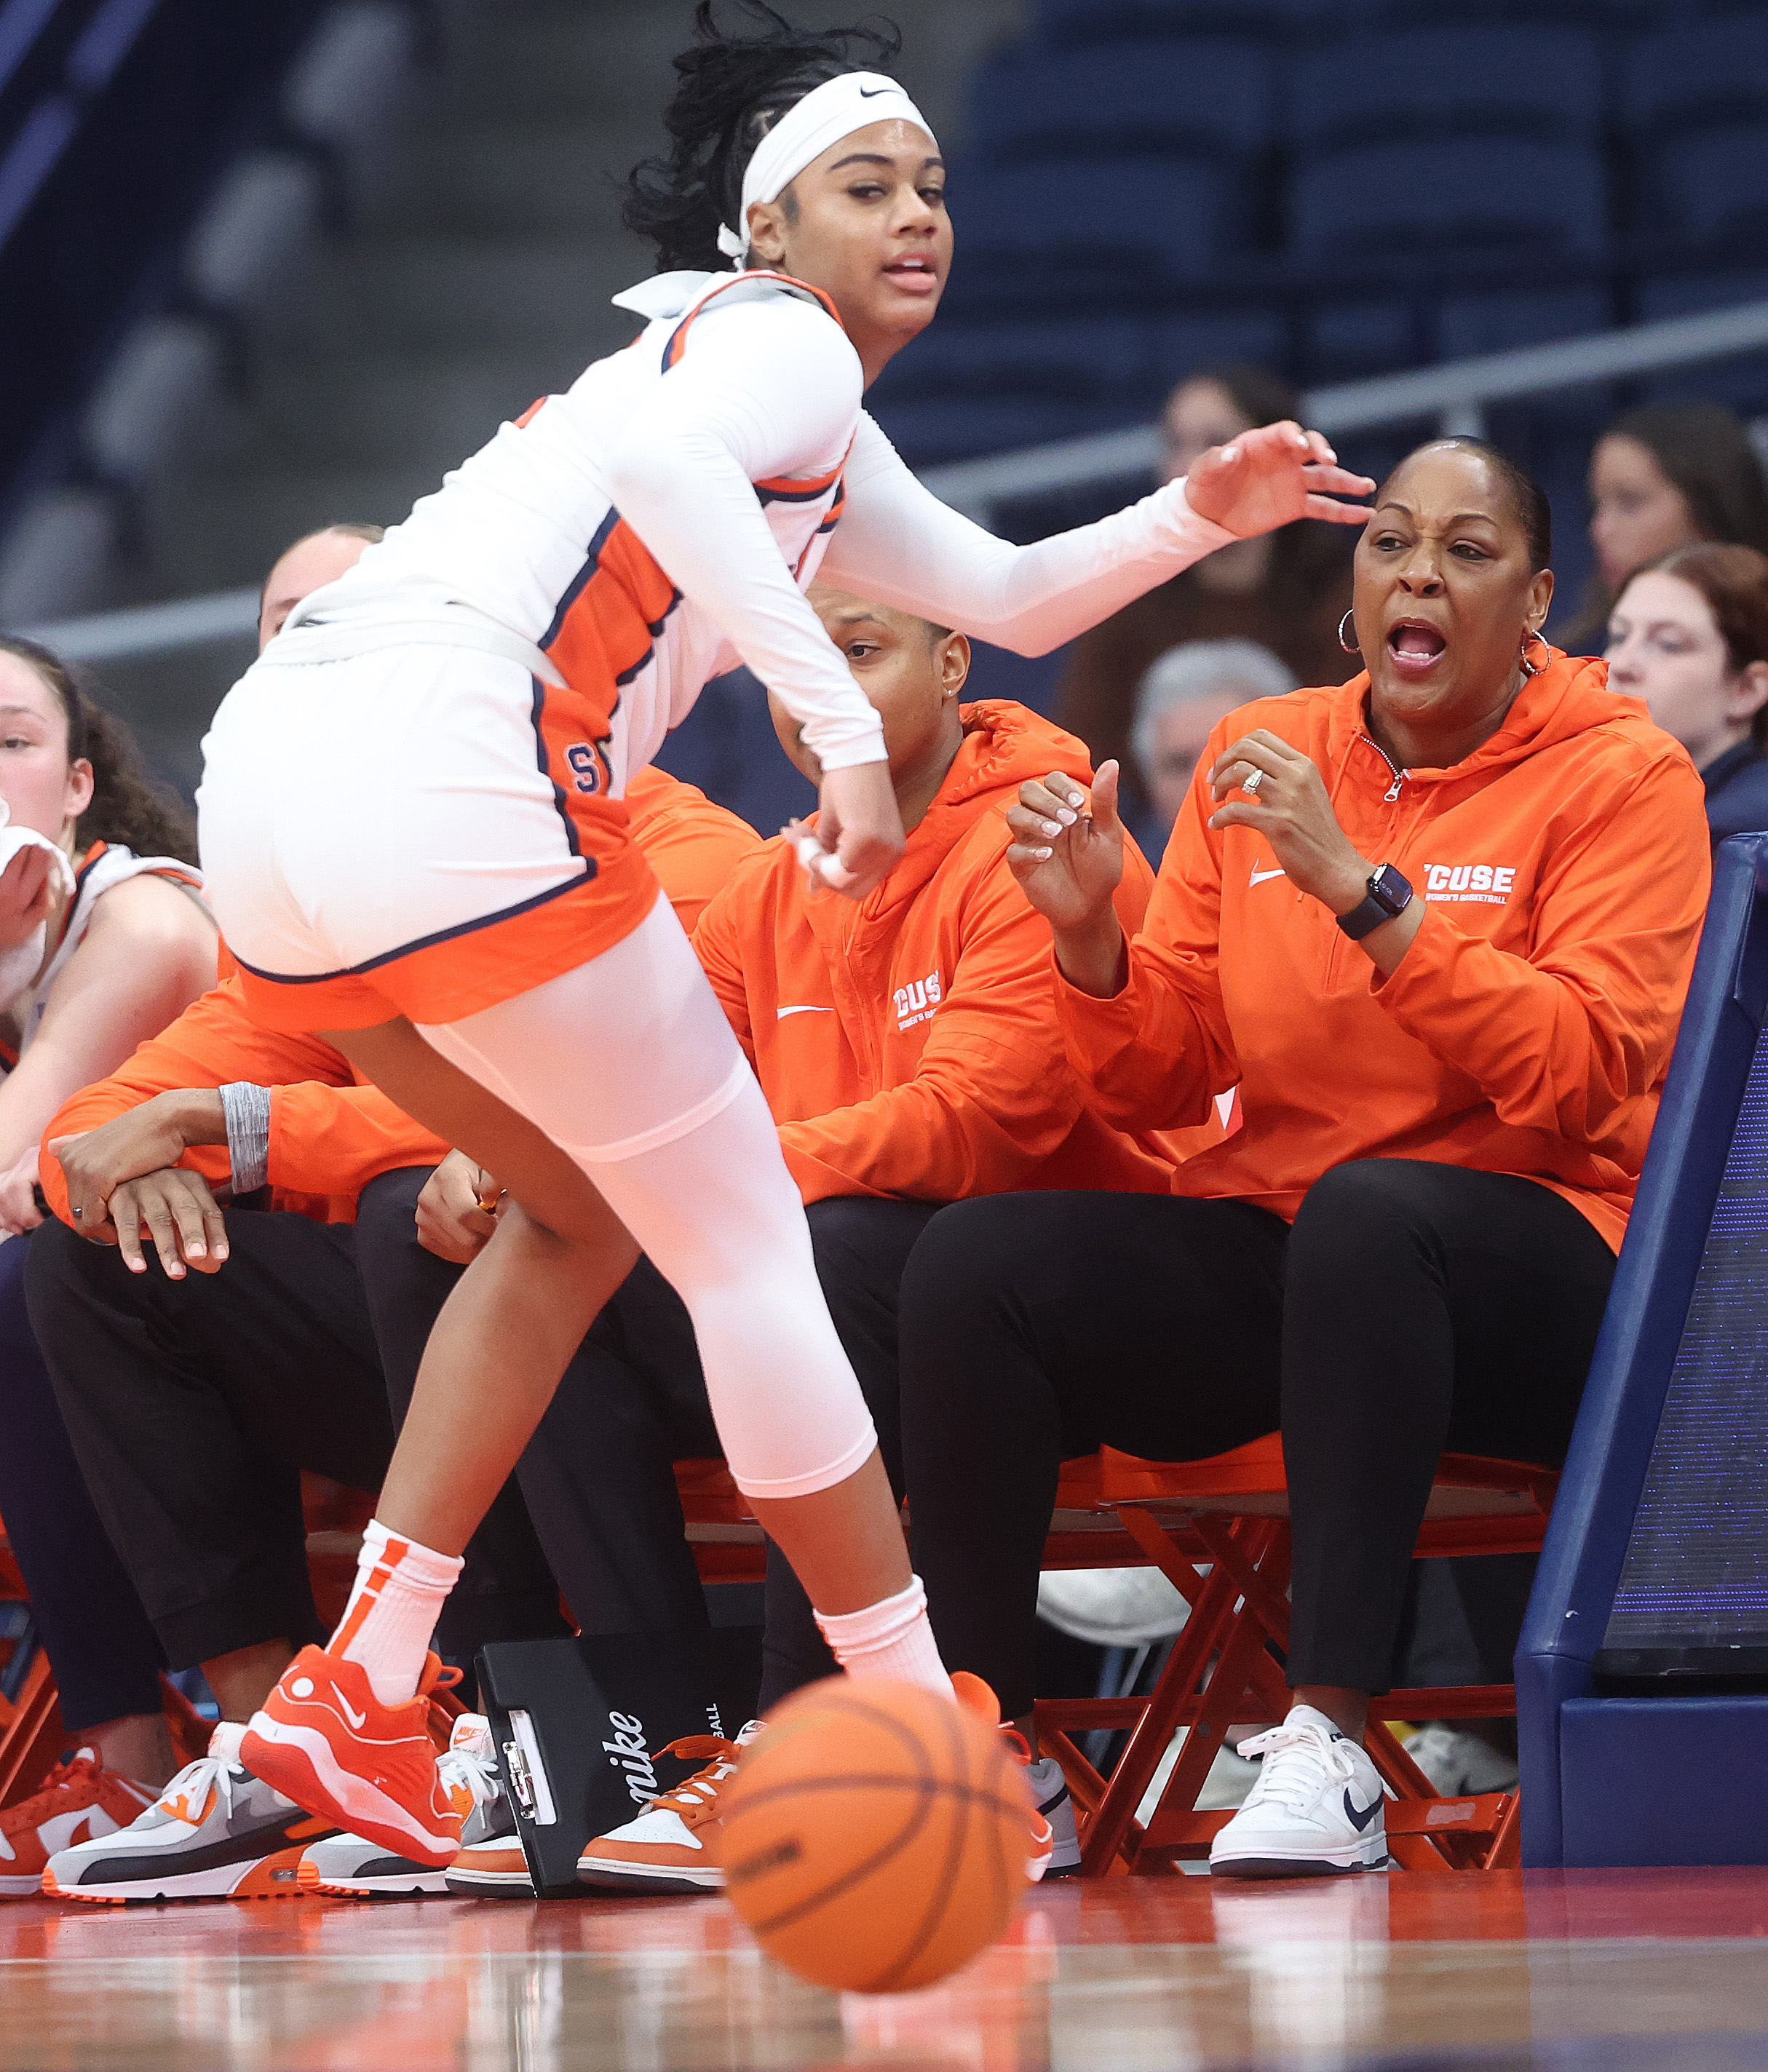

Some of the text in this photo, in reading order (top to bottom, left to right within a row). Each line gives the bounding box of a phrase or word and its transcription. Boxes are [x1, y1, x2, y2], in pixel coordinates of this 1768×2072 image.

[563, 742, 601, 795] S
[1425, 892, 1507, 905] WOMEN'S BASKETBALL
[892, 969, 941, 1017] 'CUS
[602, 1711, 660, 1803] nike
